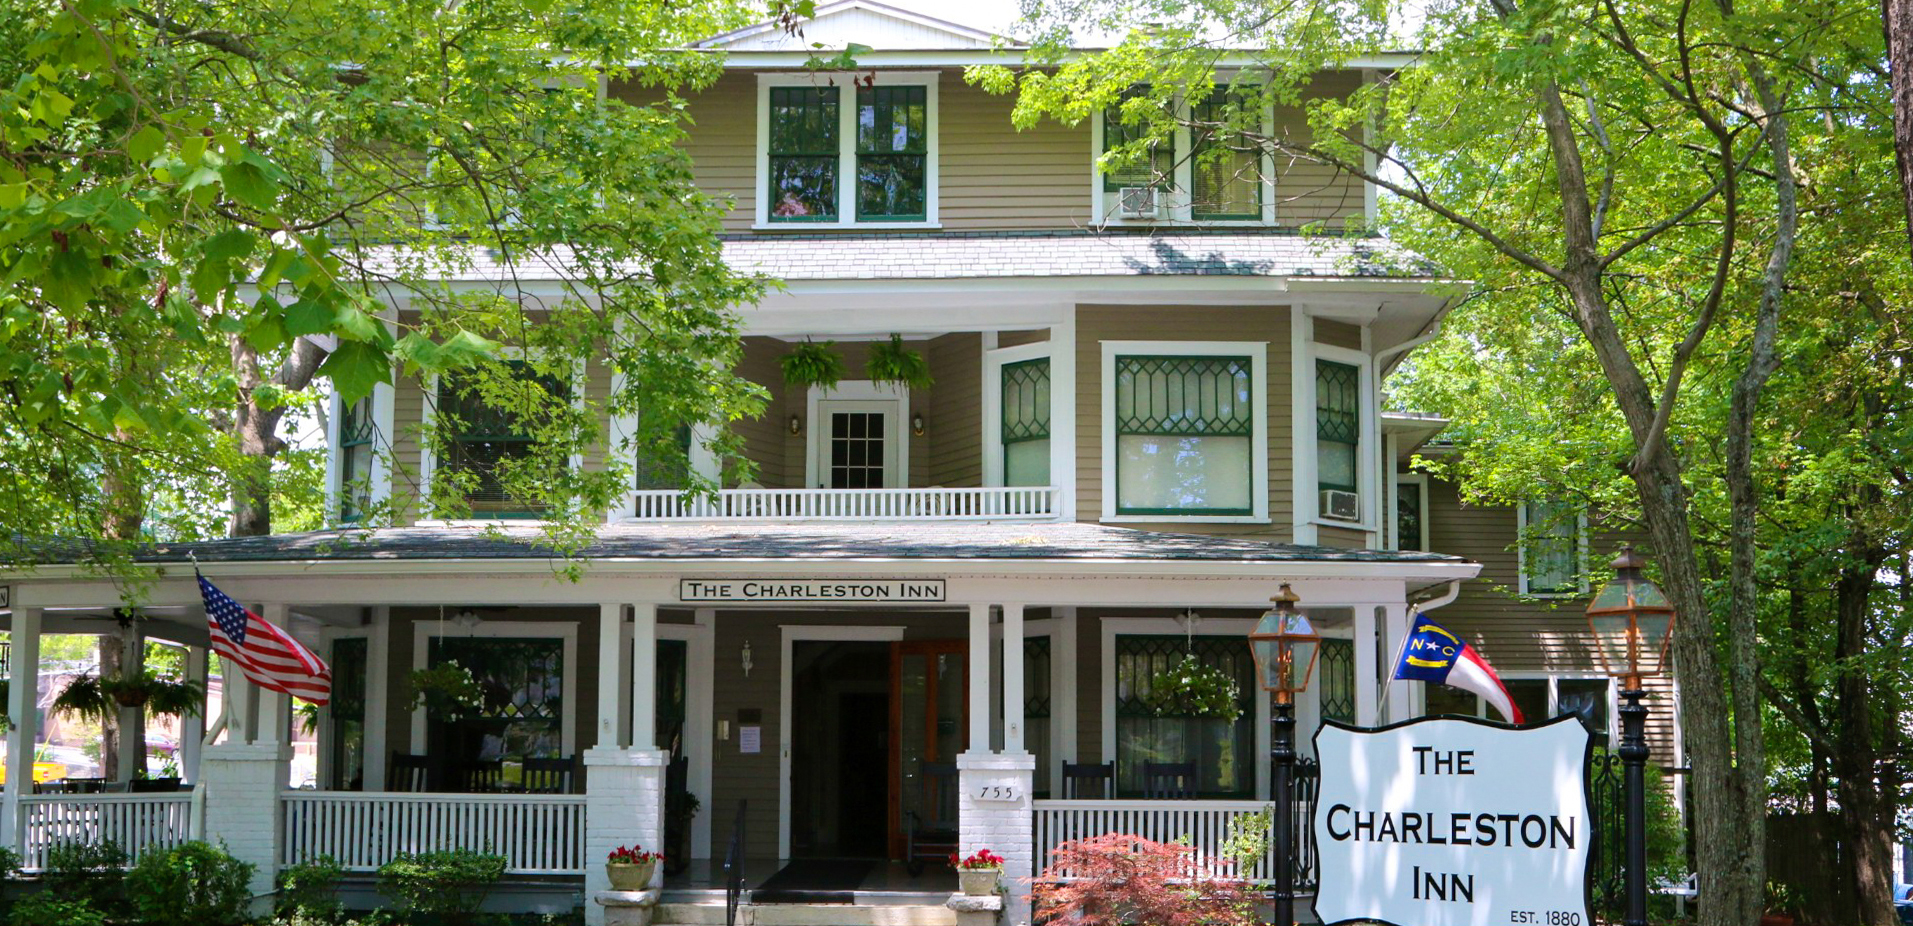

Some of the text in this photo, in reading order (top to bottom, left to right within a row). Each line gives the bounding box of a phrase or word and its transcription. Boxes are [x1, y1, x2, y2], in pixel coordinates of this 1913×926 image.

[688, 583, 938, 597] THE CHARLESTON INN
[1413, 746, 1475, 775] THE
[981, 786, 1012, 798] 755
[1326, 803, 1576, 849] CHARLESTON
[1413, 866, 1475, 903] INN
[1510, 910, 1580, 926] EST. 1880
